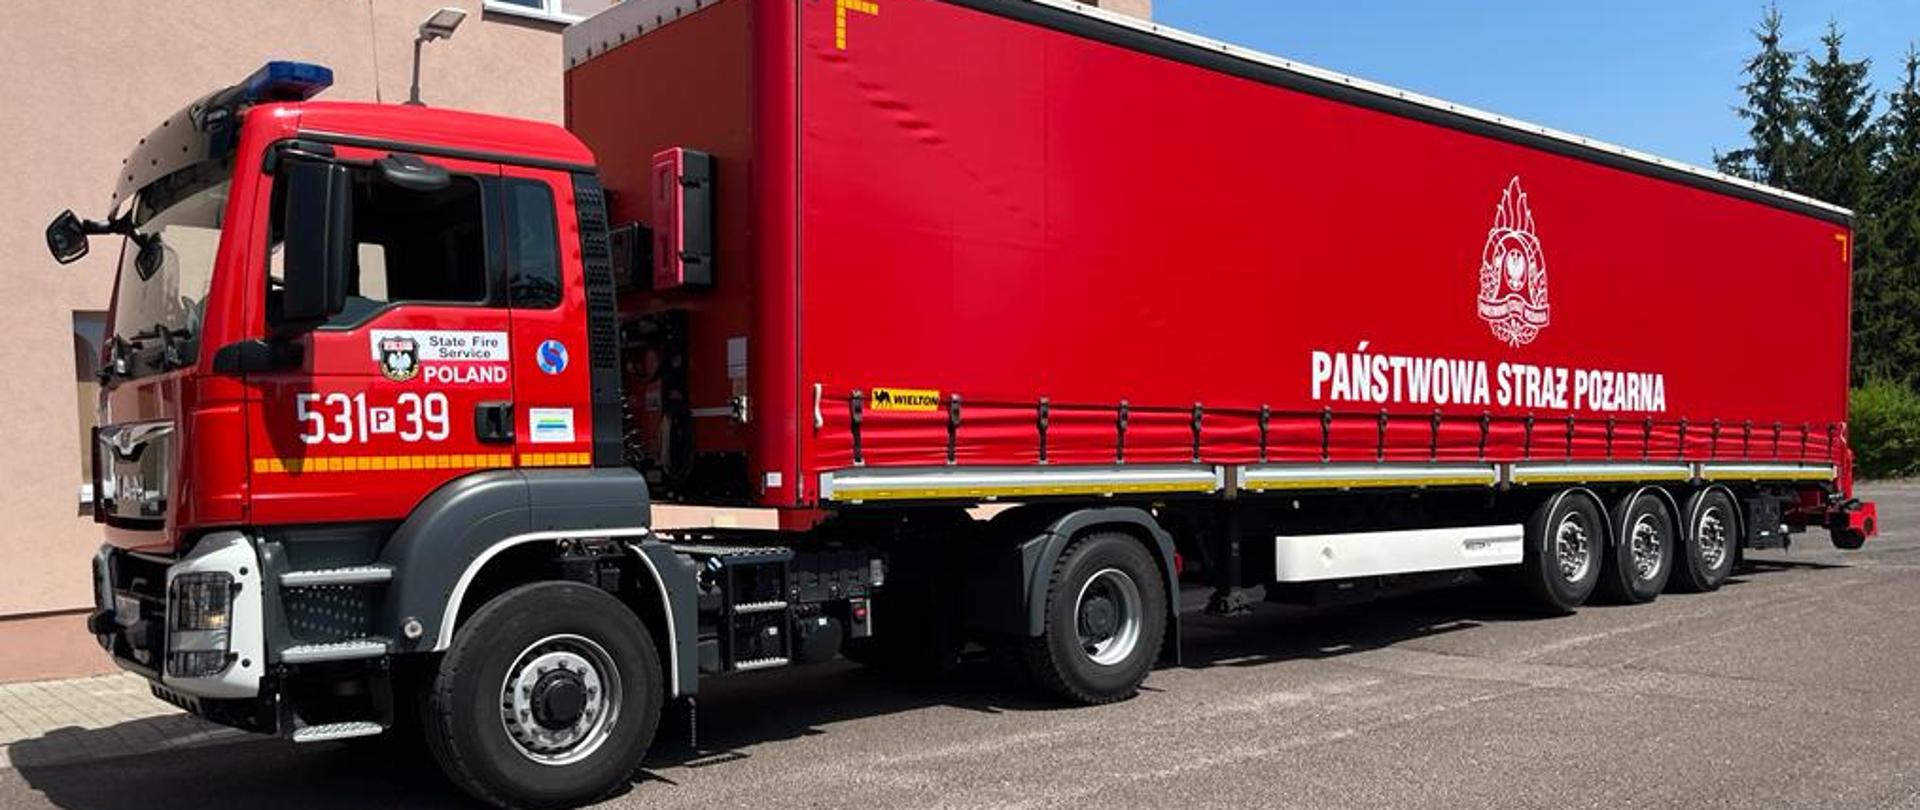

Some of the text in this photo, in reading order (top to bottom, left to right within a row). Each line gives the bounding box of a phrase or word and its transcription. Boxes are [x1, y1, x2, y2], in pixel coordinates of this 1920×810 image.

[429, 336, 499, 348] State Fire
[438, 347, 491, 358] Service
[424, 366, 507, 382] POLAND
[1312, 340, 1491, 405] PAŃSTWOWA
[893, 394, 939, 406] WIELTON
